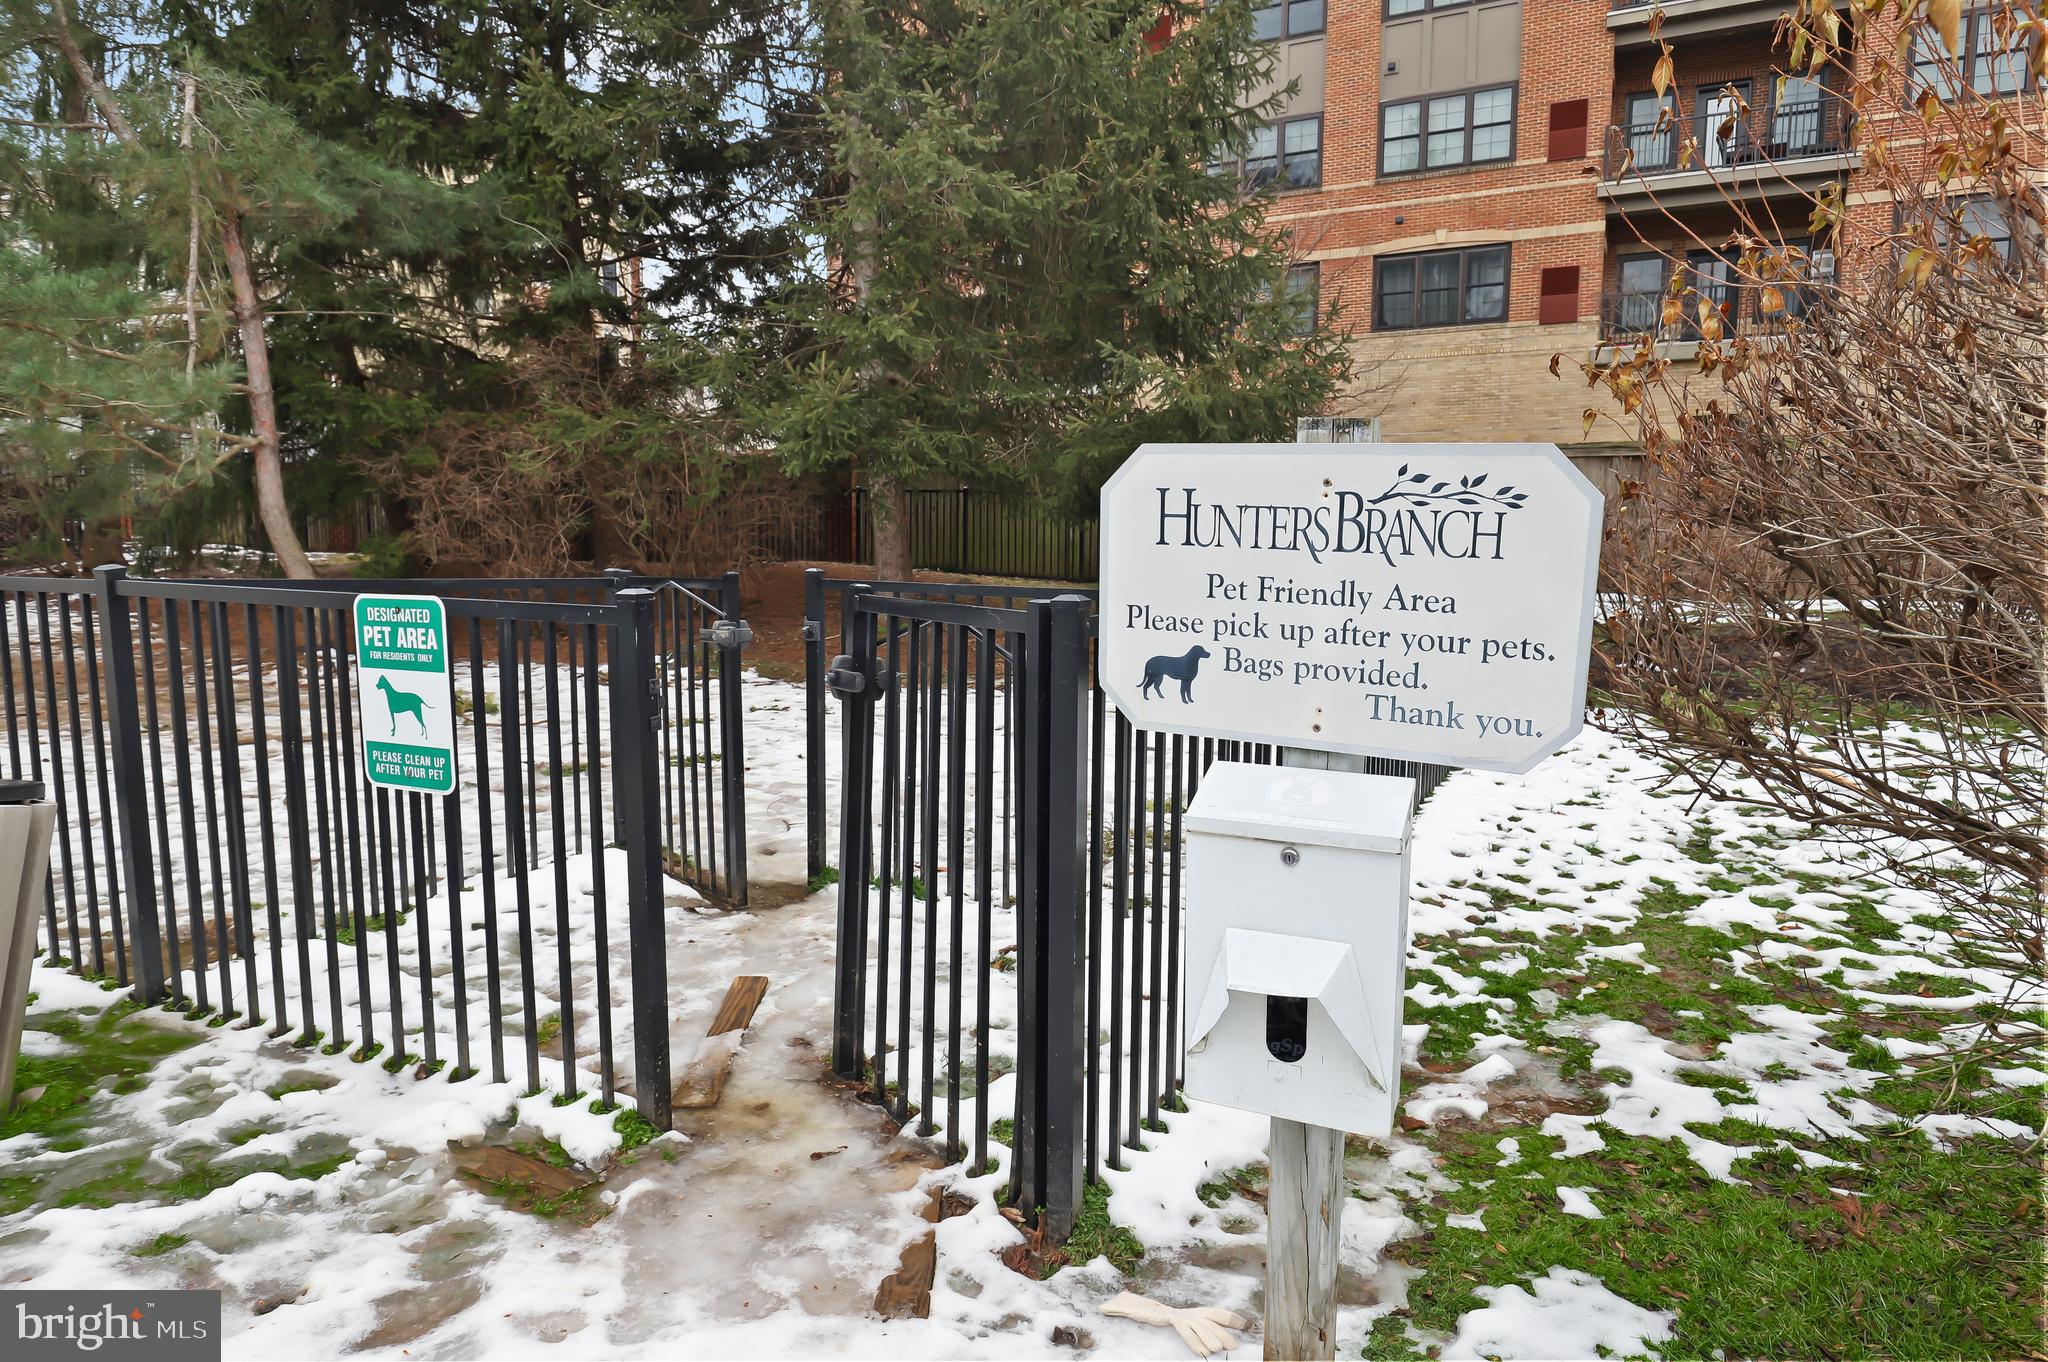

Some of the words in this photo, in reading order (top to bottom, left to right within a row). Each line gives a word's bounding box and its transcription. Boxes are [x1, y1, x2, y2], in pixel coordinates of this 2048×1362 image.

[1206, 573, 1248, 601] Pet
[1256, 575, 1373, 615] Friendly
[1382, 583, 1457, 615] Area
[366, 606, 431, 624] DESIGNATED
[363, 625, 391, 648] PET
[396, 626, 438, 651] AREA
[1126, 604, 1204, 634] Please
[1212, 611, 1270, 642] pick
[1279, 623, 1314, 649] up
[1324, 617, 1391, 648] after
[1400, 632, 1472, 657] your
[1480, 637, 1555, 664] pets.
[369, 650, 382, 660] FOR
[382, 651, 415, 662] RESIDENTS
[417, 653, 433, 663] ONLY
[1222, 646, 1284, 682] Bags
[1293, 658, 1428, 690] provided.
[1364, 693, 1465, 730] Thank
[1475, 714, 1543, 739] you.
[372, 750, 402, 764] PLEASE
[404, 753, 431, 767] CLEAN
[433, 756, 446, 769] UP
[375, 762, 401, 776] AFTER
[402, 765, 426, 779] YOUR
[428, 768, 444, 781] PET
